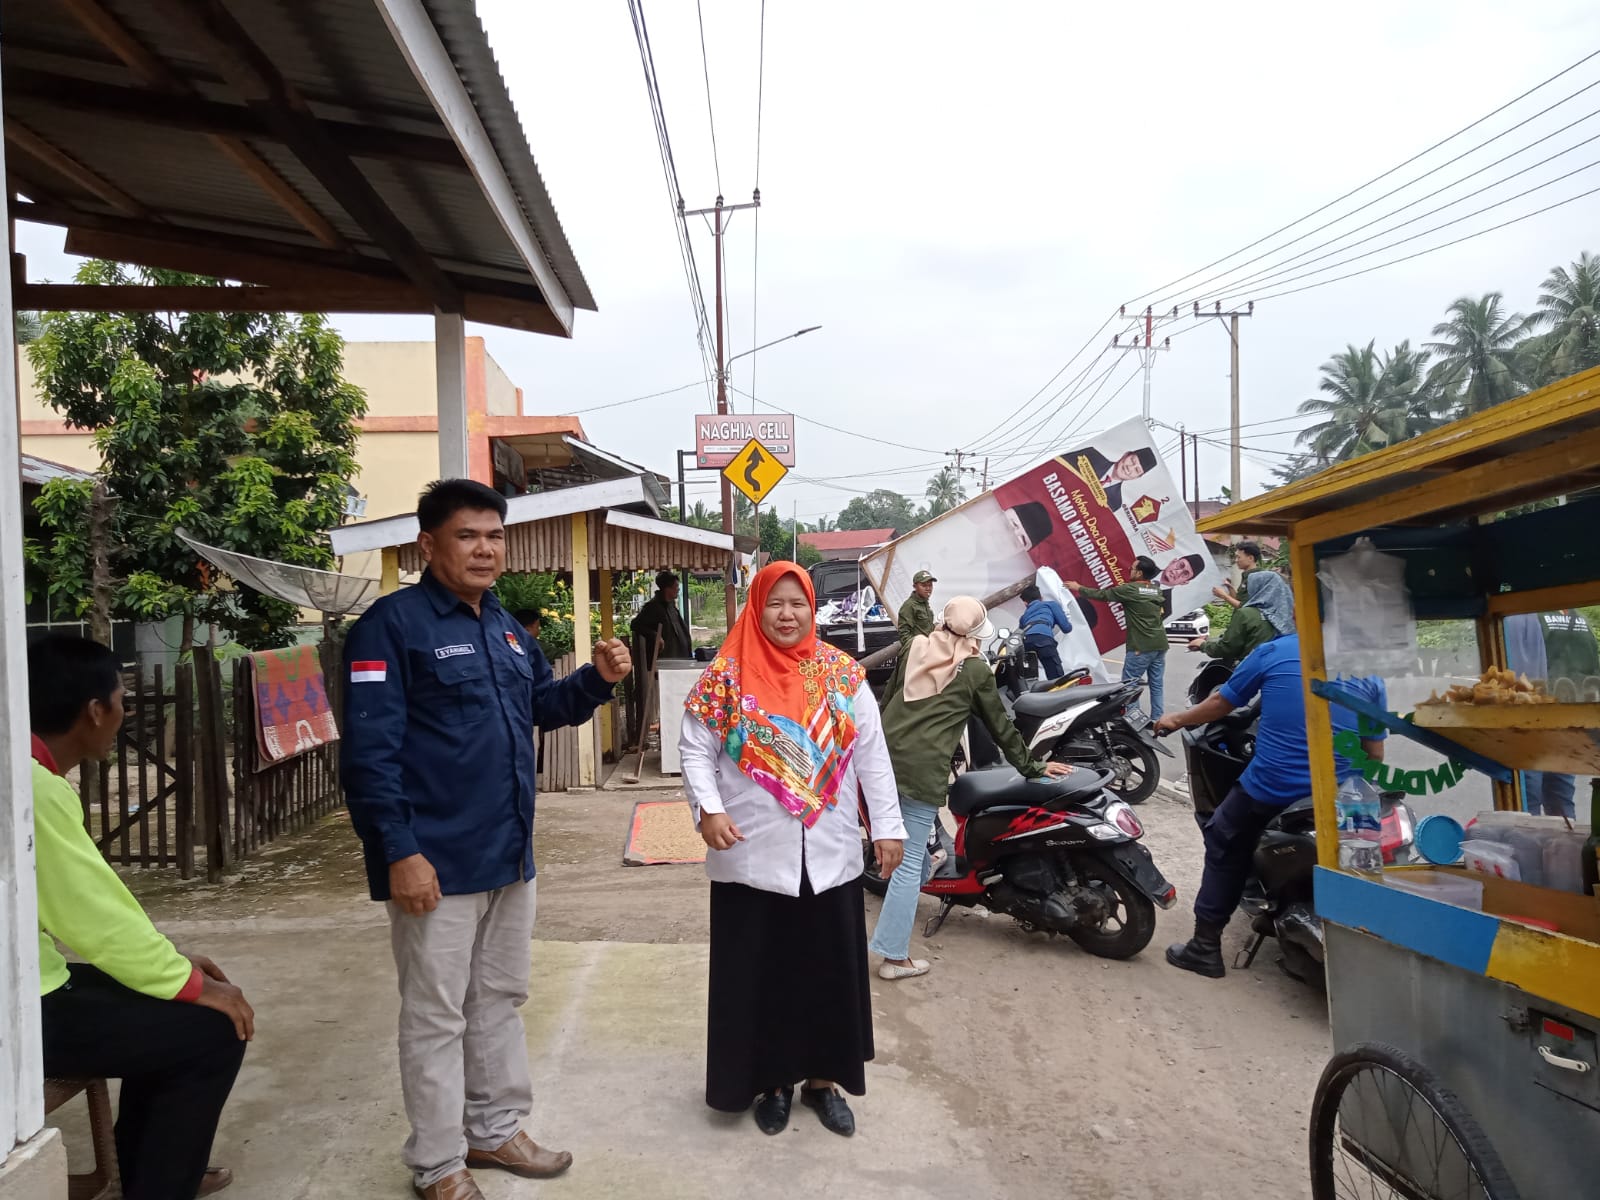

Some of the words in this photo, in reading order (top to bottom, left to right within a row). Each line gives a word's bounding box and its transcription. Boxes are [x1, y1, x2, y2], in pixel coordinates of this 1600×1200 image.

[700, 422, 755, 440] NAGHIA
[758, 422, 789, 440] CELL
[1042, 472, 1077, 521] BASAMO
[1067, 519, 1114, 589] MEMBANGUN
[1071, 489, 1090, 519] Mohon
[1086, 516, 1100, 538] Doa
[1096, 536, 1111, 558] Dan
[1106, 555, 1126, 587] Dukun
